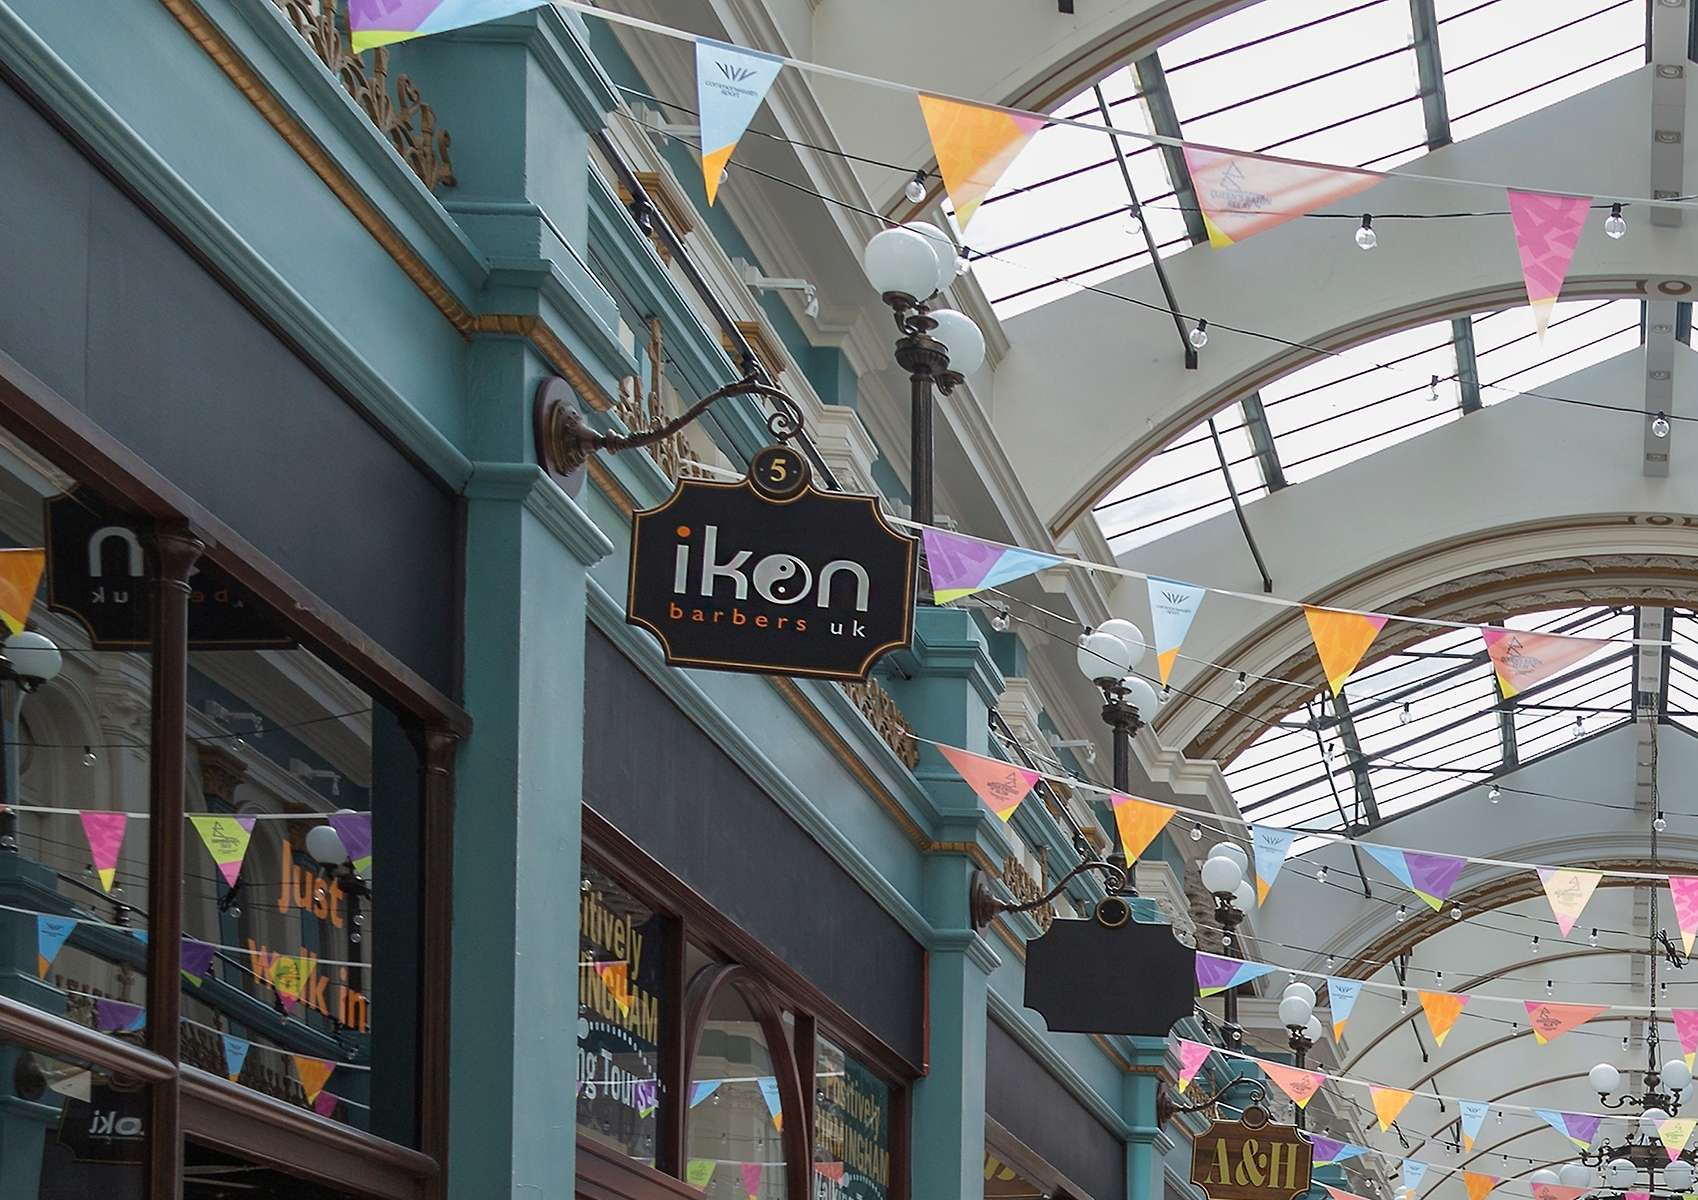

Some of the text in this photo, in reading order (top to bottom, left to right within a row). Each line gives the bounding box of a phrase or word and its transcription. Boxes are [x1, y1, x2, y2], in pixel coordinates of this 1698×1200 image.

[770, 458, 786, 482] 5
[674, 525, 870, 612] ikon
[669, 602, 866, 638] barbers uk
[277, 839, 343, 929] Just
[578, 890, 643, 980] itively
[339, 967, 367, 1034] in
[579, 951, 658, 1046] INGHAM
[1203, 1137, 1299, 1191] A&H
